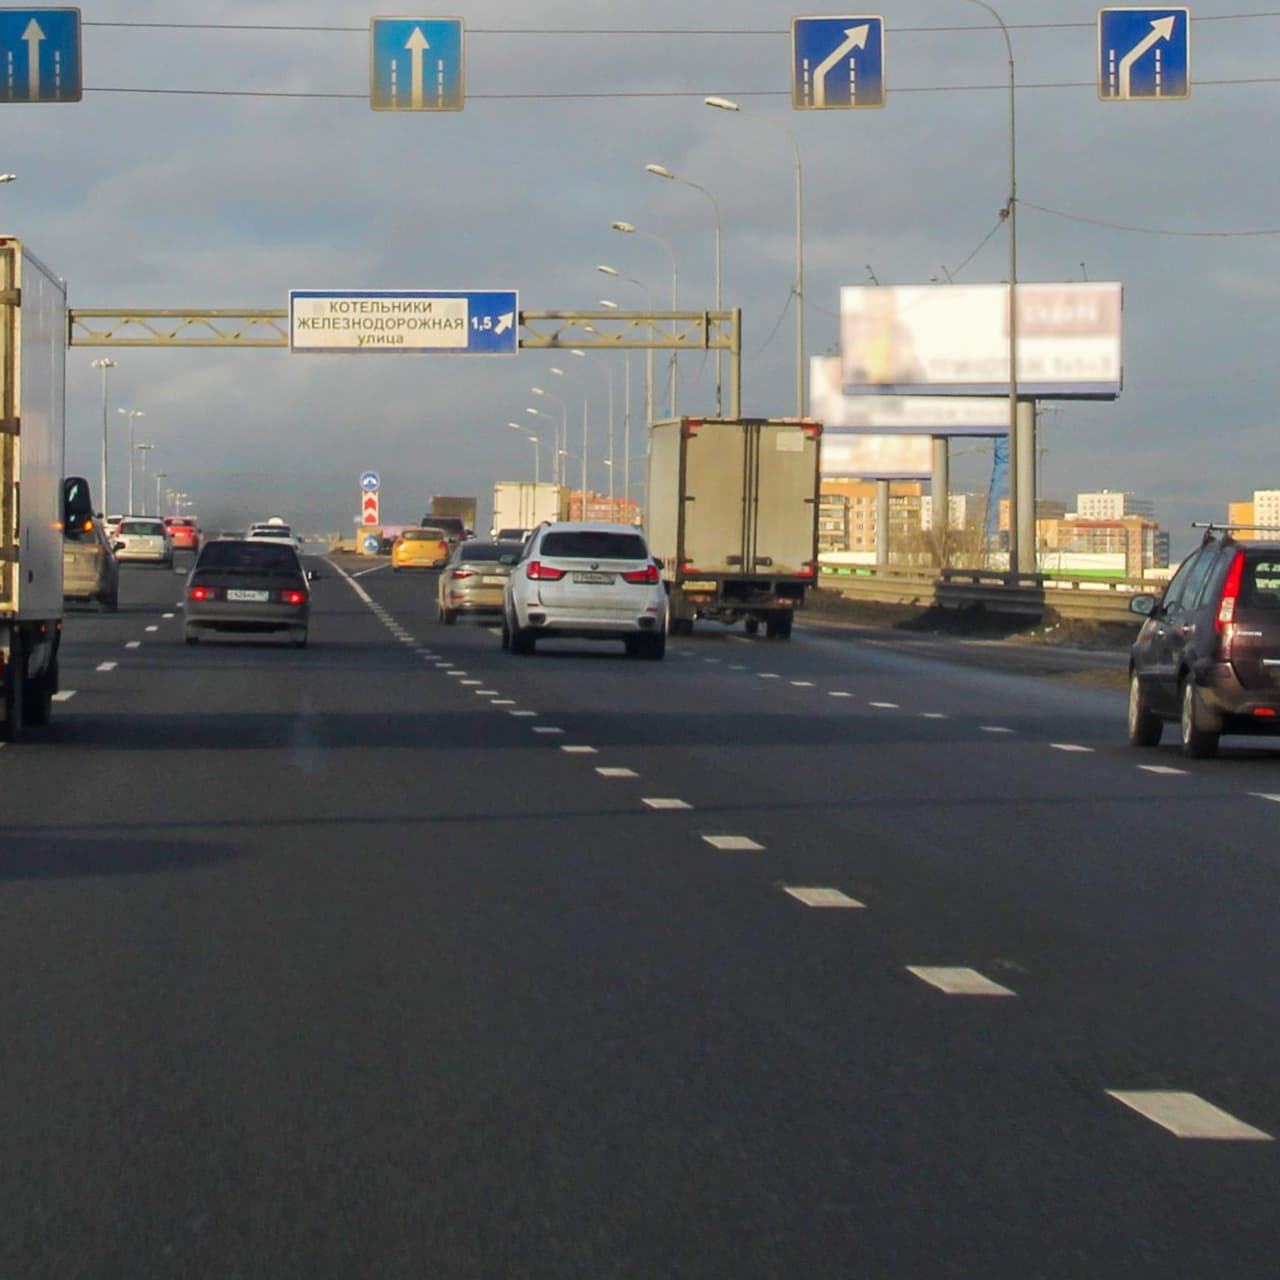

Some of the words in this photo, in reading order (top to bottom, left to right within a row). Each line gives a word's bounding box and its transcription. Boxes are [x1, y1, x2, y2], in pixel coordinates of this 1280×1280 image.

[329, 301, 433, 313] КОТЕЛЬНИКИ
[297, 317, 464, 331] ЖЕЛЕЗНОДОРОЖНАЯ
[471, 317, 492, 331] 1,5
[357, 333, 404, 345] улица
